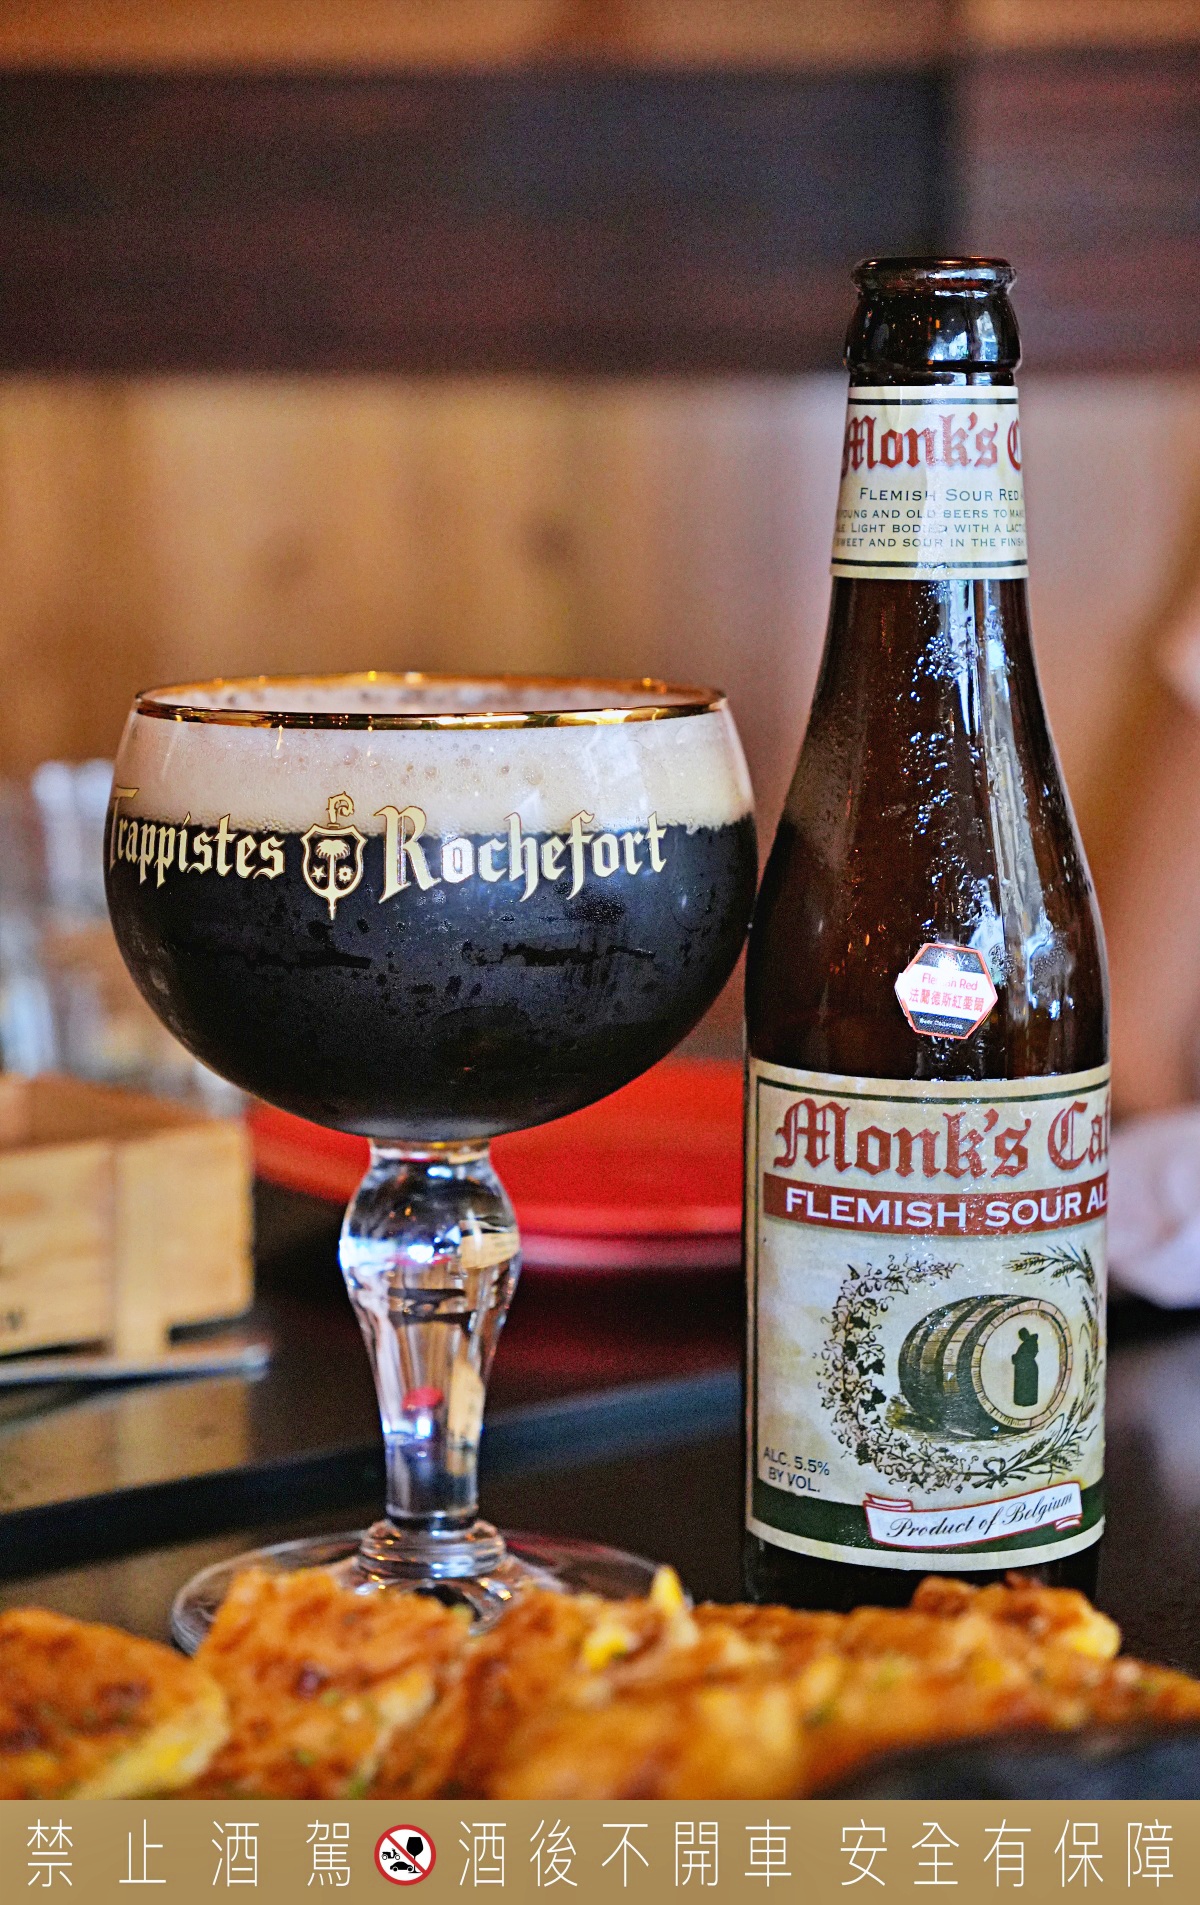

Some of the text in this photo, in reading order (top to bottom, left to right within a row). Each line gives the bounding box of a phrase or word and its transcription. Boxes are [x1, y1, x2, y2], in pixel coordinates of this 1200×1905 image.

[842, 411, 999, 478] Monk's
[859, 487, 936, 502] FLEMISH
[945, 488, 994, 502] SOUR
[999, 488, 1019, 501] RED
[851, 522, 886, 533] LIGHT
[953, 524, 990, 534] WITH
[994, 524, 1002, 533] A
[872, 509, 901, 519] AND
[906, 509, 936, 519] OLD
[943, 509, 989, 519] BEERS
[993, 509, 1008, 519] TO
[868, 539, 897, 548] AND
[902, 539, 943, 548] SOUR
[950, 539, 964, 548] IN
[971, 539, 996, 548] THE
[109, 785, 668, 904] Trappistes Rochefort
[959, 978, 978, 991] Red
[773, 1098, 1032, 1180] Monk's
[785, 1187, 966, 1227] FLEMISH
[985, 1191, 1082, 1227] SOUR
[764, 1446, 830, 1476] ALC. 5.5%
[769, 1466, 820, 1492] BY VOL.
[886, 1493, 1073, 1538] Product of Belgium
